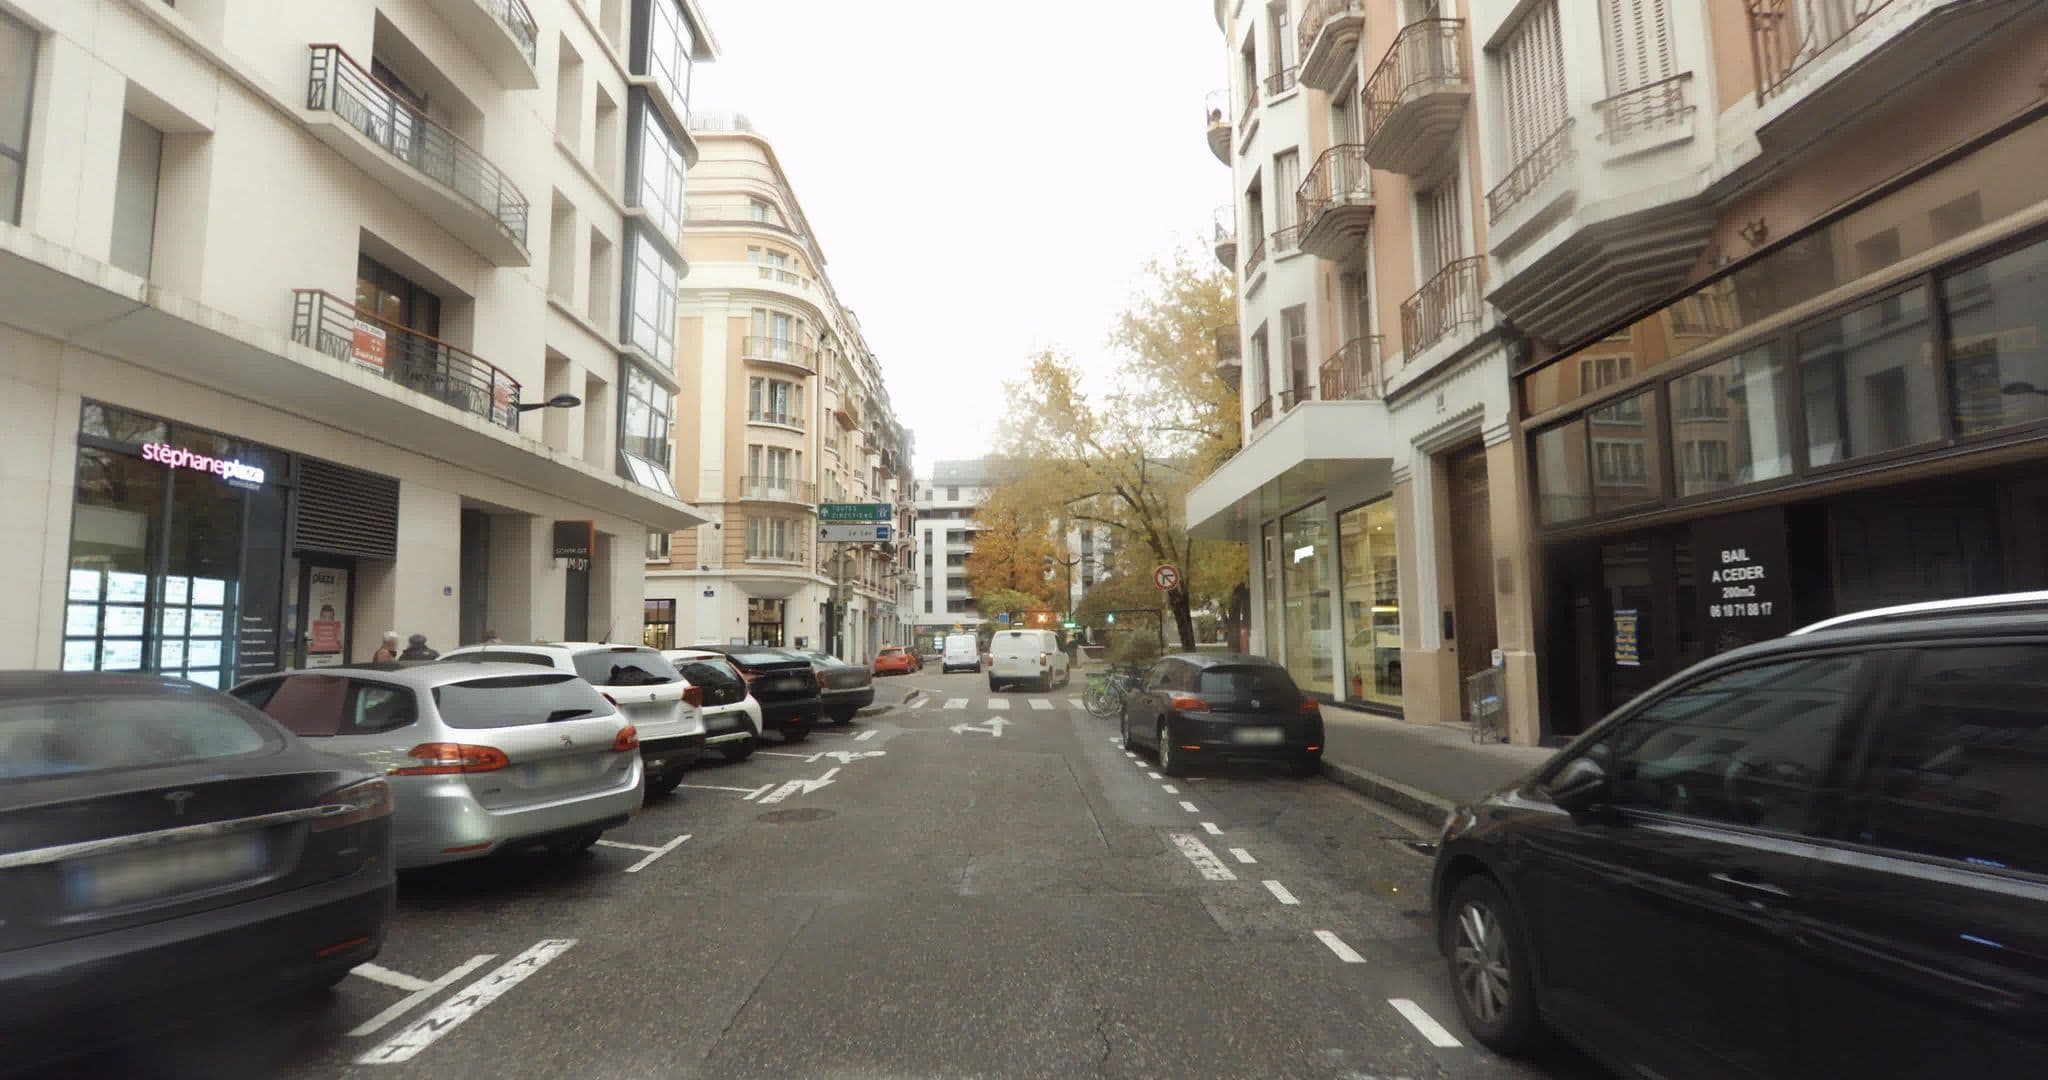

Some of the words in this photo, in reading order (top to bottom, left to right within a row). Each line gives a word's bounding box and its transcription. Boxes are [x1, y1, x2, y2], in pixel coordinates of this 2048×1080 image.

[1721, 549, 1750, 563] BAIL
[1711, 570, 1721, 583] A
[1722, 565, 1765, 582] CEDER
